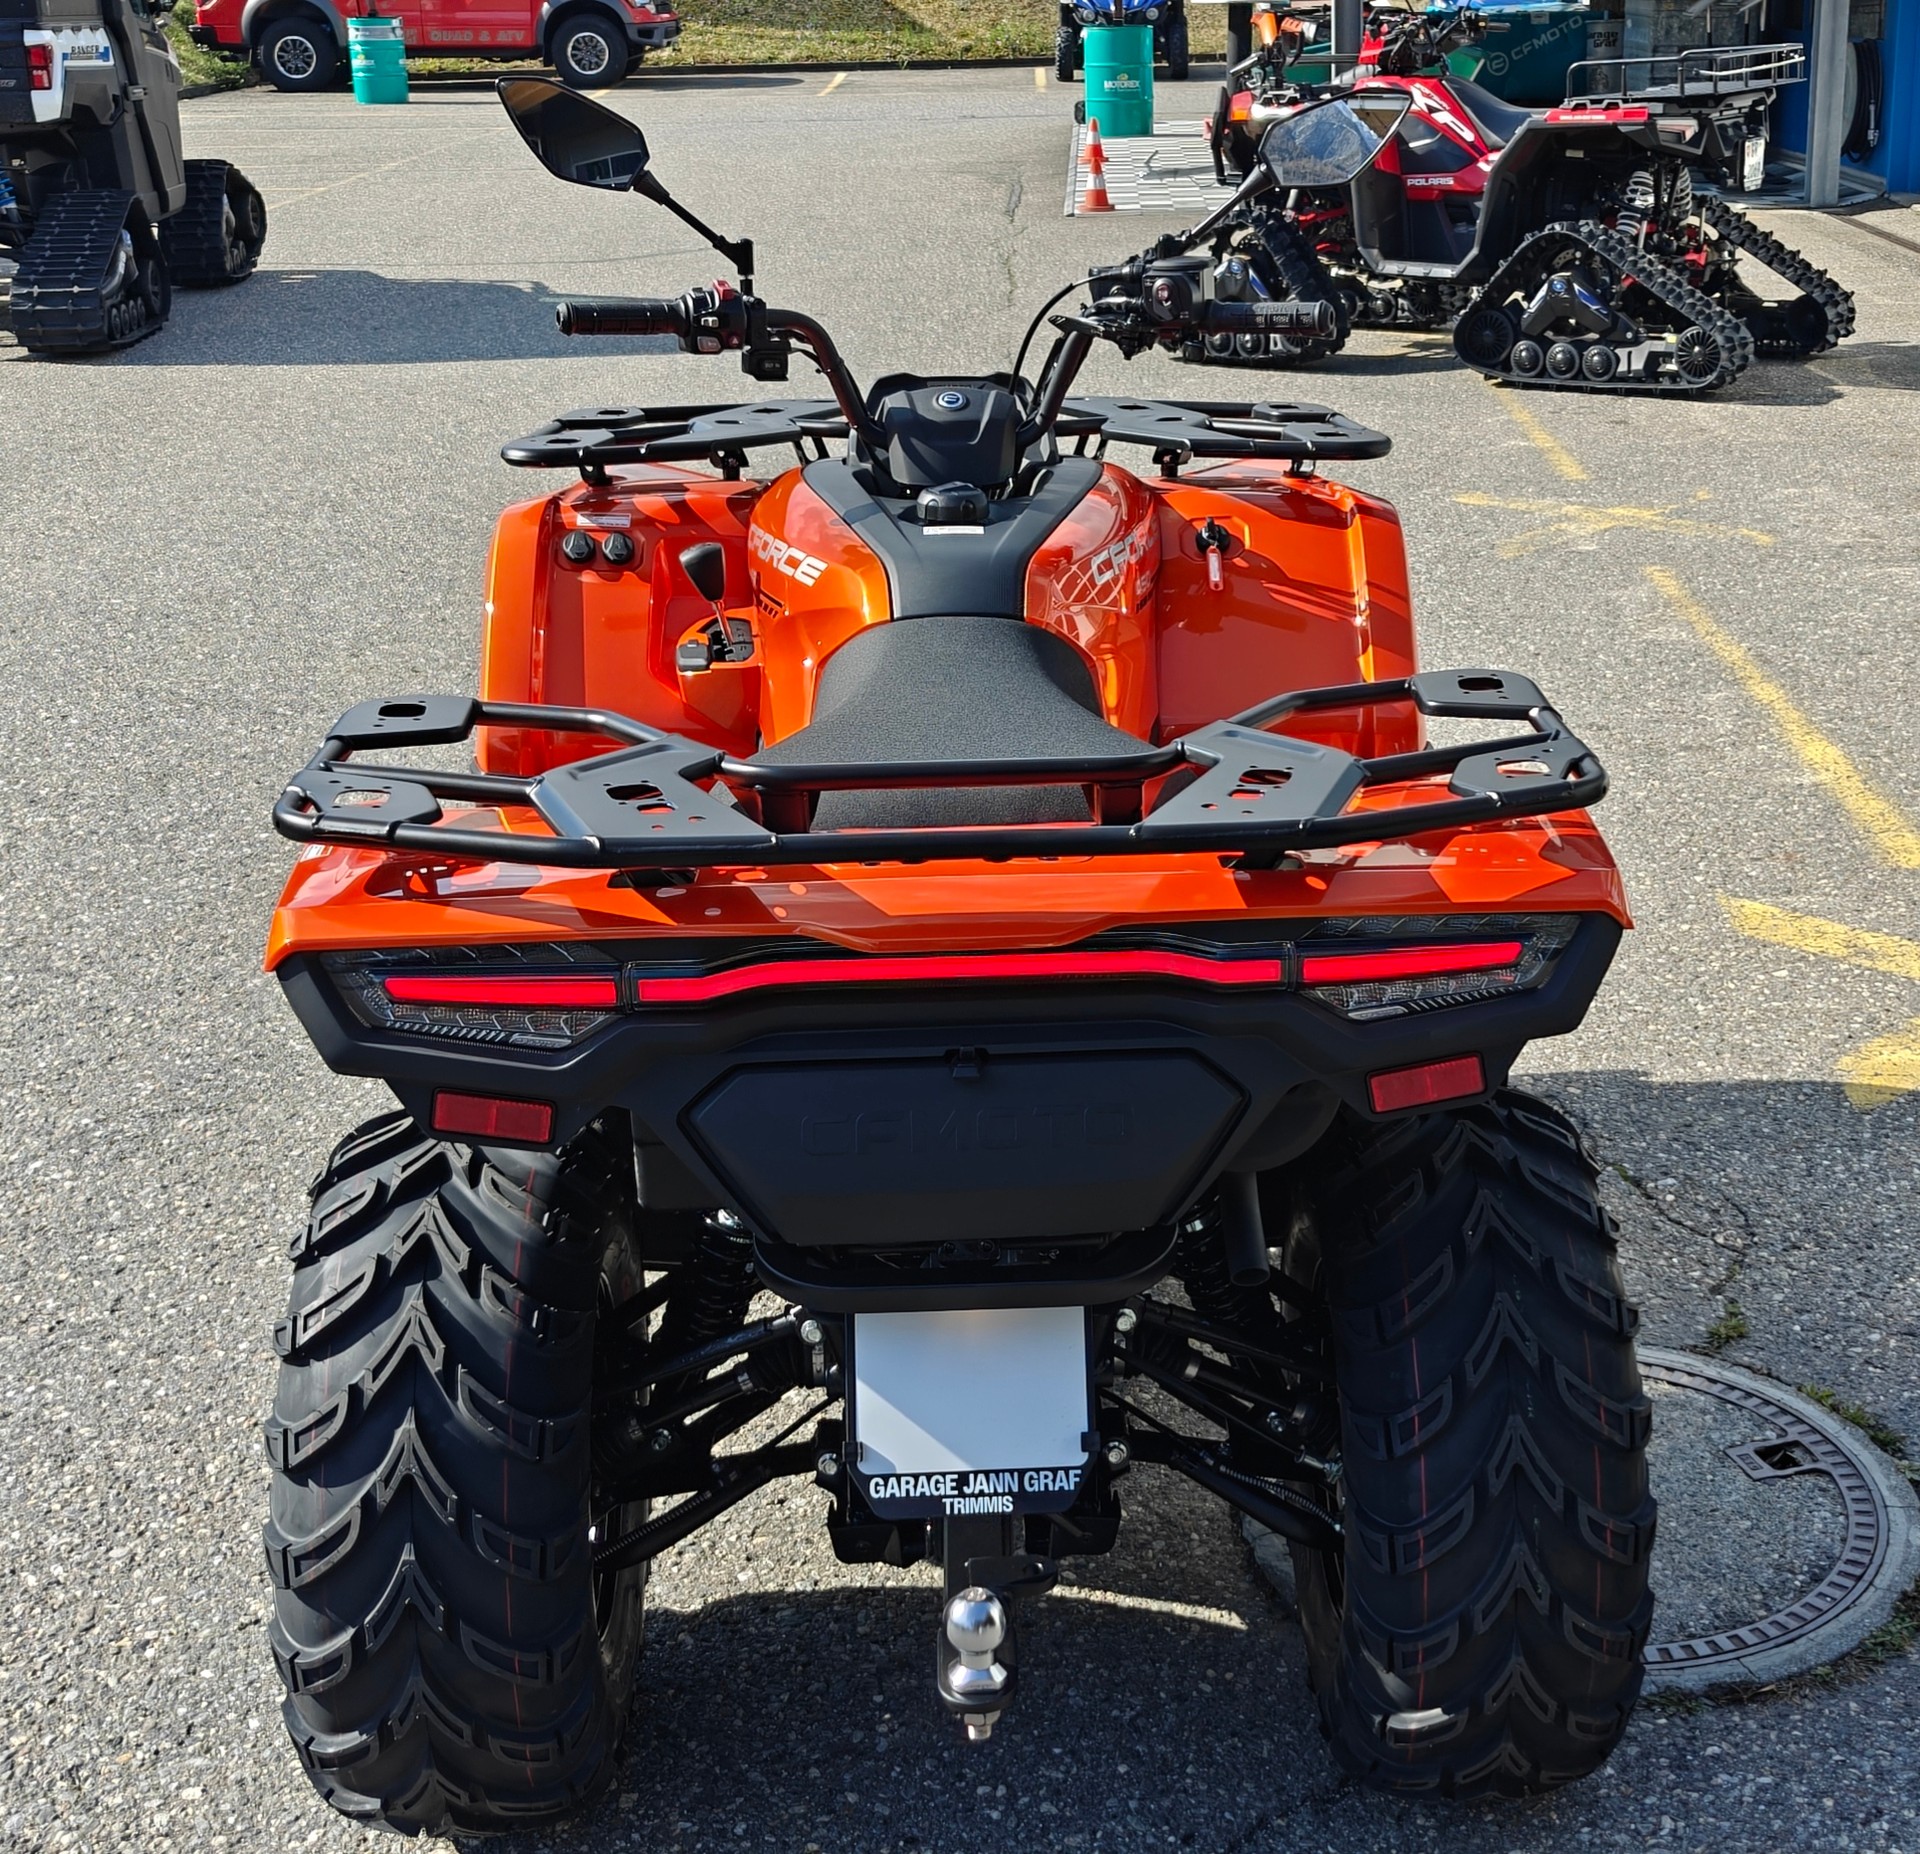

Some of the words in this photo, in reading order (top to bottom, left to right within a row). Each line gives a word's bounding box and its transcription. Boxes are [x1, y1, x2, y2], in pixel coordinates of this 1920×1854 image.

[430, 30, 473, 42] QUAD
[496, 30, 525, 41] ATV
[1511, 15, 1583, 60] CFMOTO
[71, 44, 100, 55] RANGER
[1103, 80, 1140, 89] MOTOREX
[1407, 177, 1454, 186] POLARIS
[800, 1103, 1135, 1157] CFMOTO
[869, 1474, 959, 1499] GARAGE
[963, 1472, 1018, 1496] JANN
[1024, 1470, 1082, 1493] GRAF
[942, 1495, 1014, 1515] TRIMMIS
